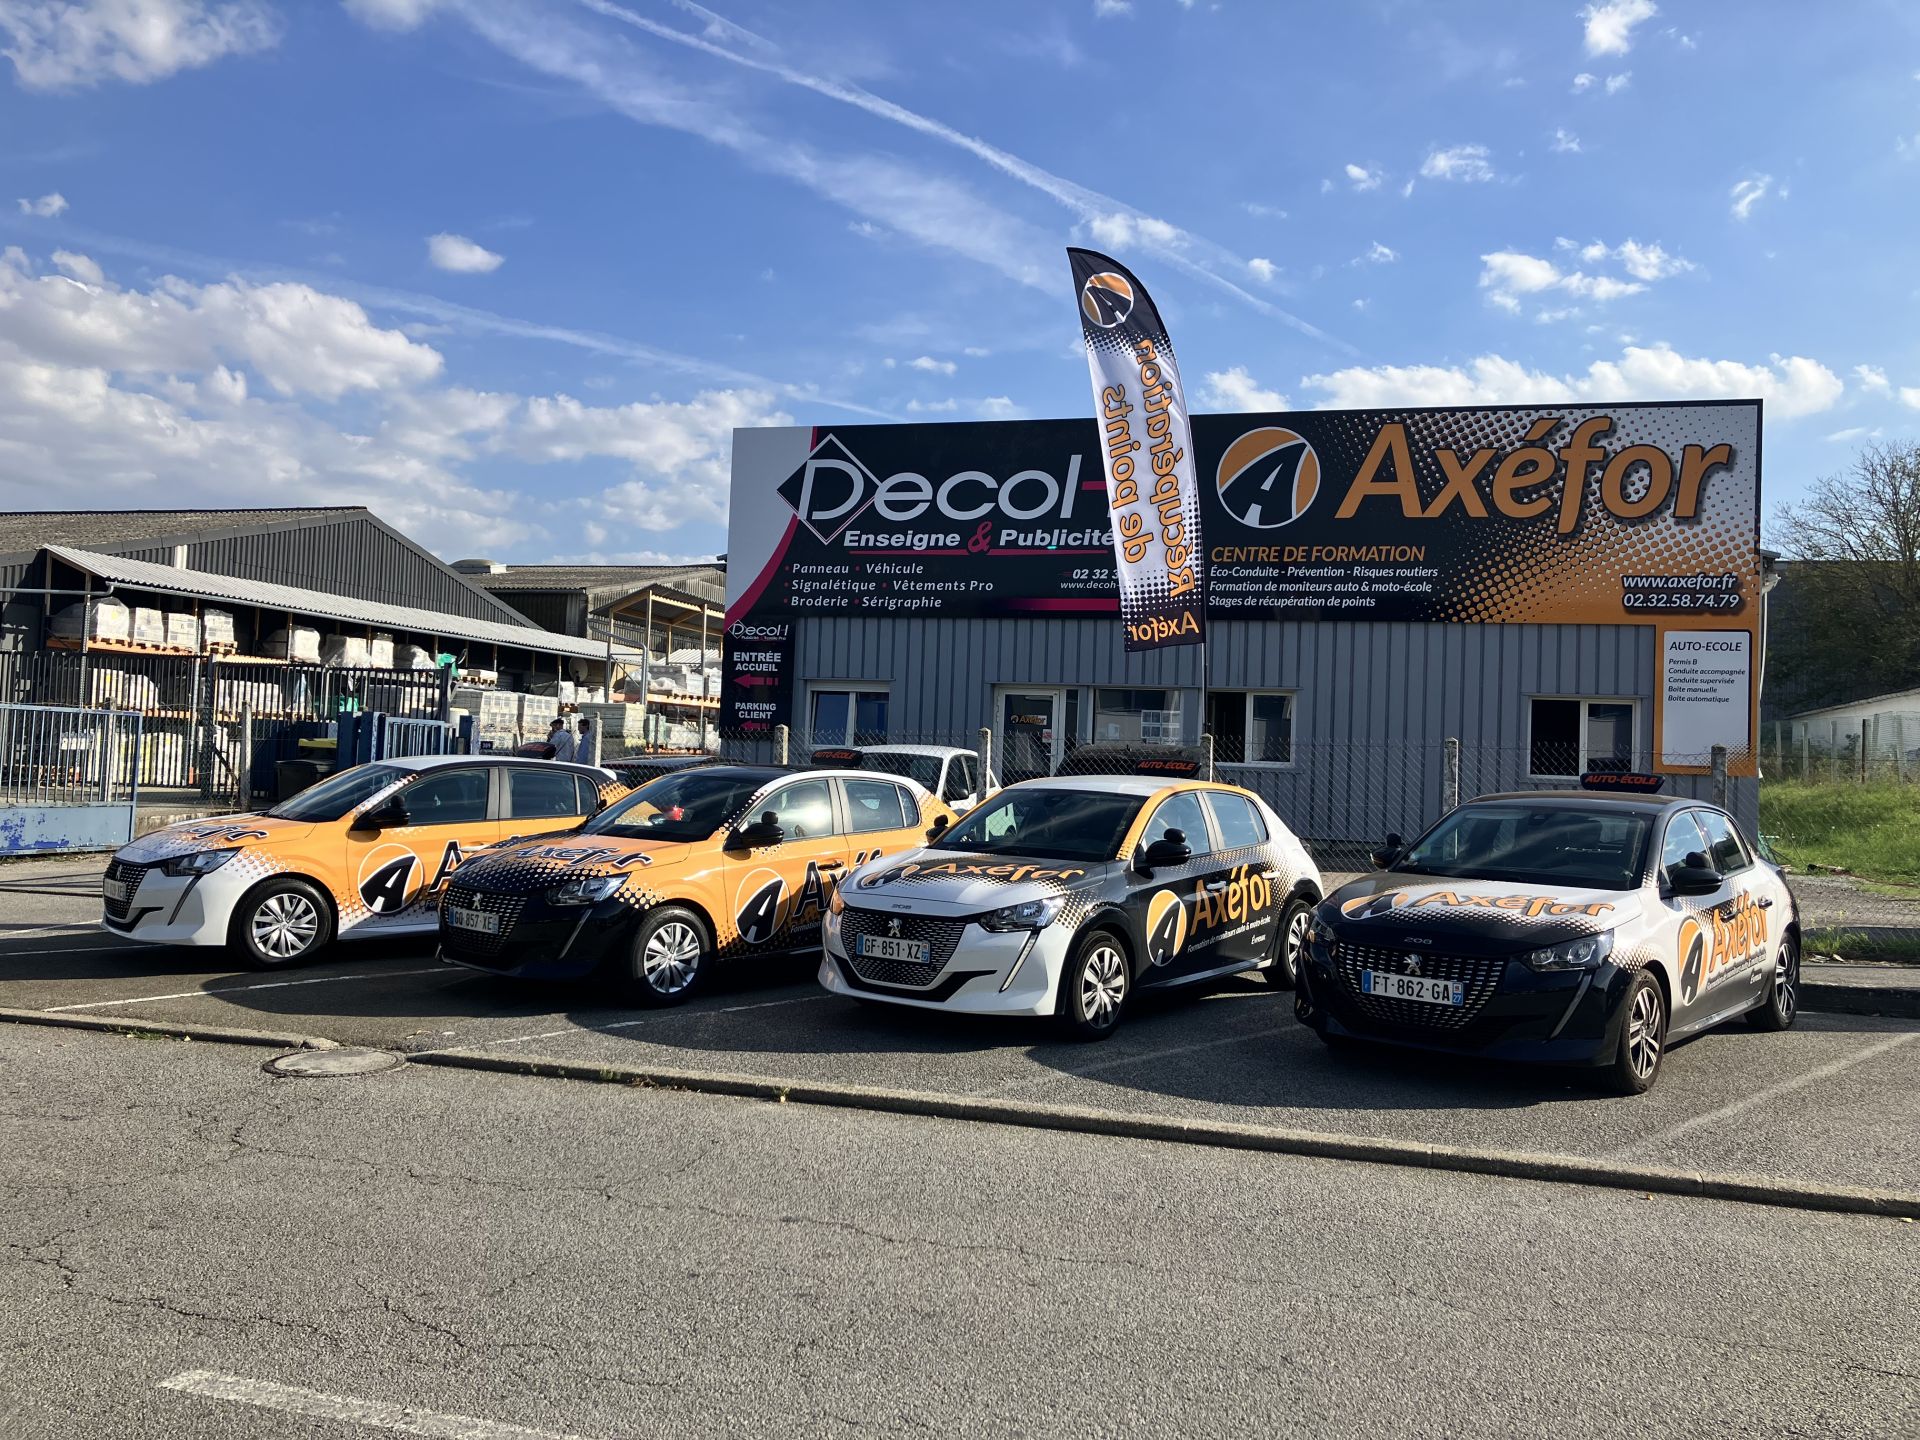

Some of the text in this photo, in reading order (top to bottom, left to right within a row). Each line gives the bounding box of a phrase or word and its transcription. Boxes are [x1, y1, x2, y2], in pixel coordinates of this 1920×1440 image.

[1333, 414, 1733, 536] Axéfor
[843, 521, 1115, 552] Enseigne & Publicité
[1211, 545, 1426, 562] CENTRE DE FORMATION
[792, 563, 924, 574] Panneau Véhicule
[1072, 568, 1089, 579] 02
[1092, 568, 1109, 579] 32
[1210, 565, 1279, 577] Éco-Conduite
[1287, 566, 1345, 577] Prévention
[1353, 566, 1394, 579] Risques
[1395, 566, 1439, 577] routiers
[791, 579, 994, 593] Signalétique Vêtements Pro
[1060, 580, 1120, 589] www.decoh-
[1209, 580, 1433, 592] Formation de moniteurs auto & moto-école
[1623, 574, 1736, 590] www.axefor.fr
[791, 596, 942, 610] Broderie Sérigraphie
[1208, 595, 1376, 608] Stages de récupération de points
[1623, 593, 1740, 608] 02.32.58.74.79
[1669, 641, 1743, 652] AUTO-ECOLE
[733, 651, 782, 662] ENTRÉE
[1668, 658, 1691, 666] Permis
[735, 663, 778, 671] ACCUEIL
[1668, 667, 1746, 676] Conduite accompagnée
[1686, 695, 1730, 703] automatique
[735, 702, 777, 711] PARKING
[738, 711, 773, 720] CLIENT
[921, 862, 1085, 882] Axéfor
[1189, 862, 1272, 937] Axéfor
